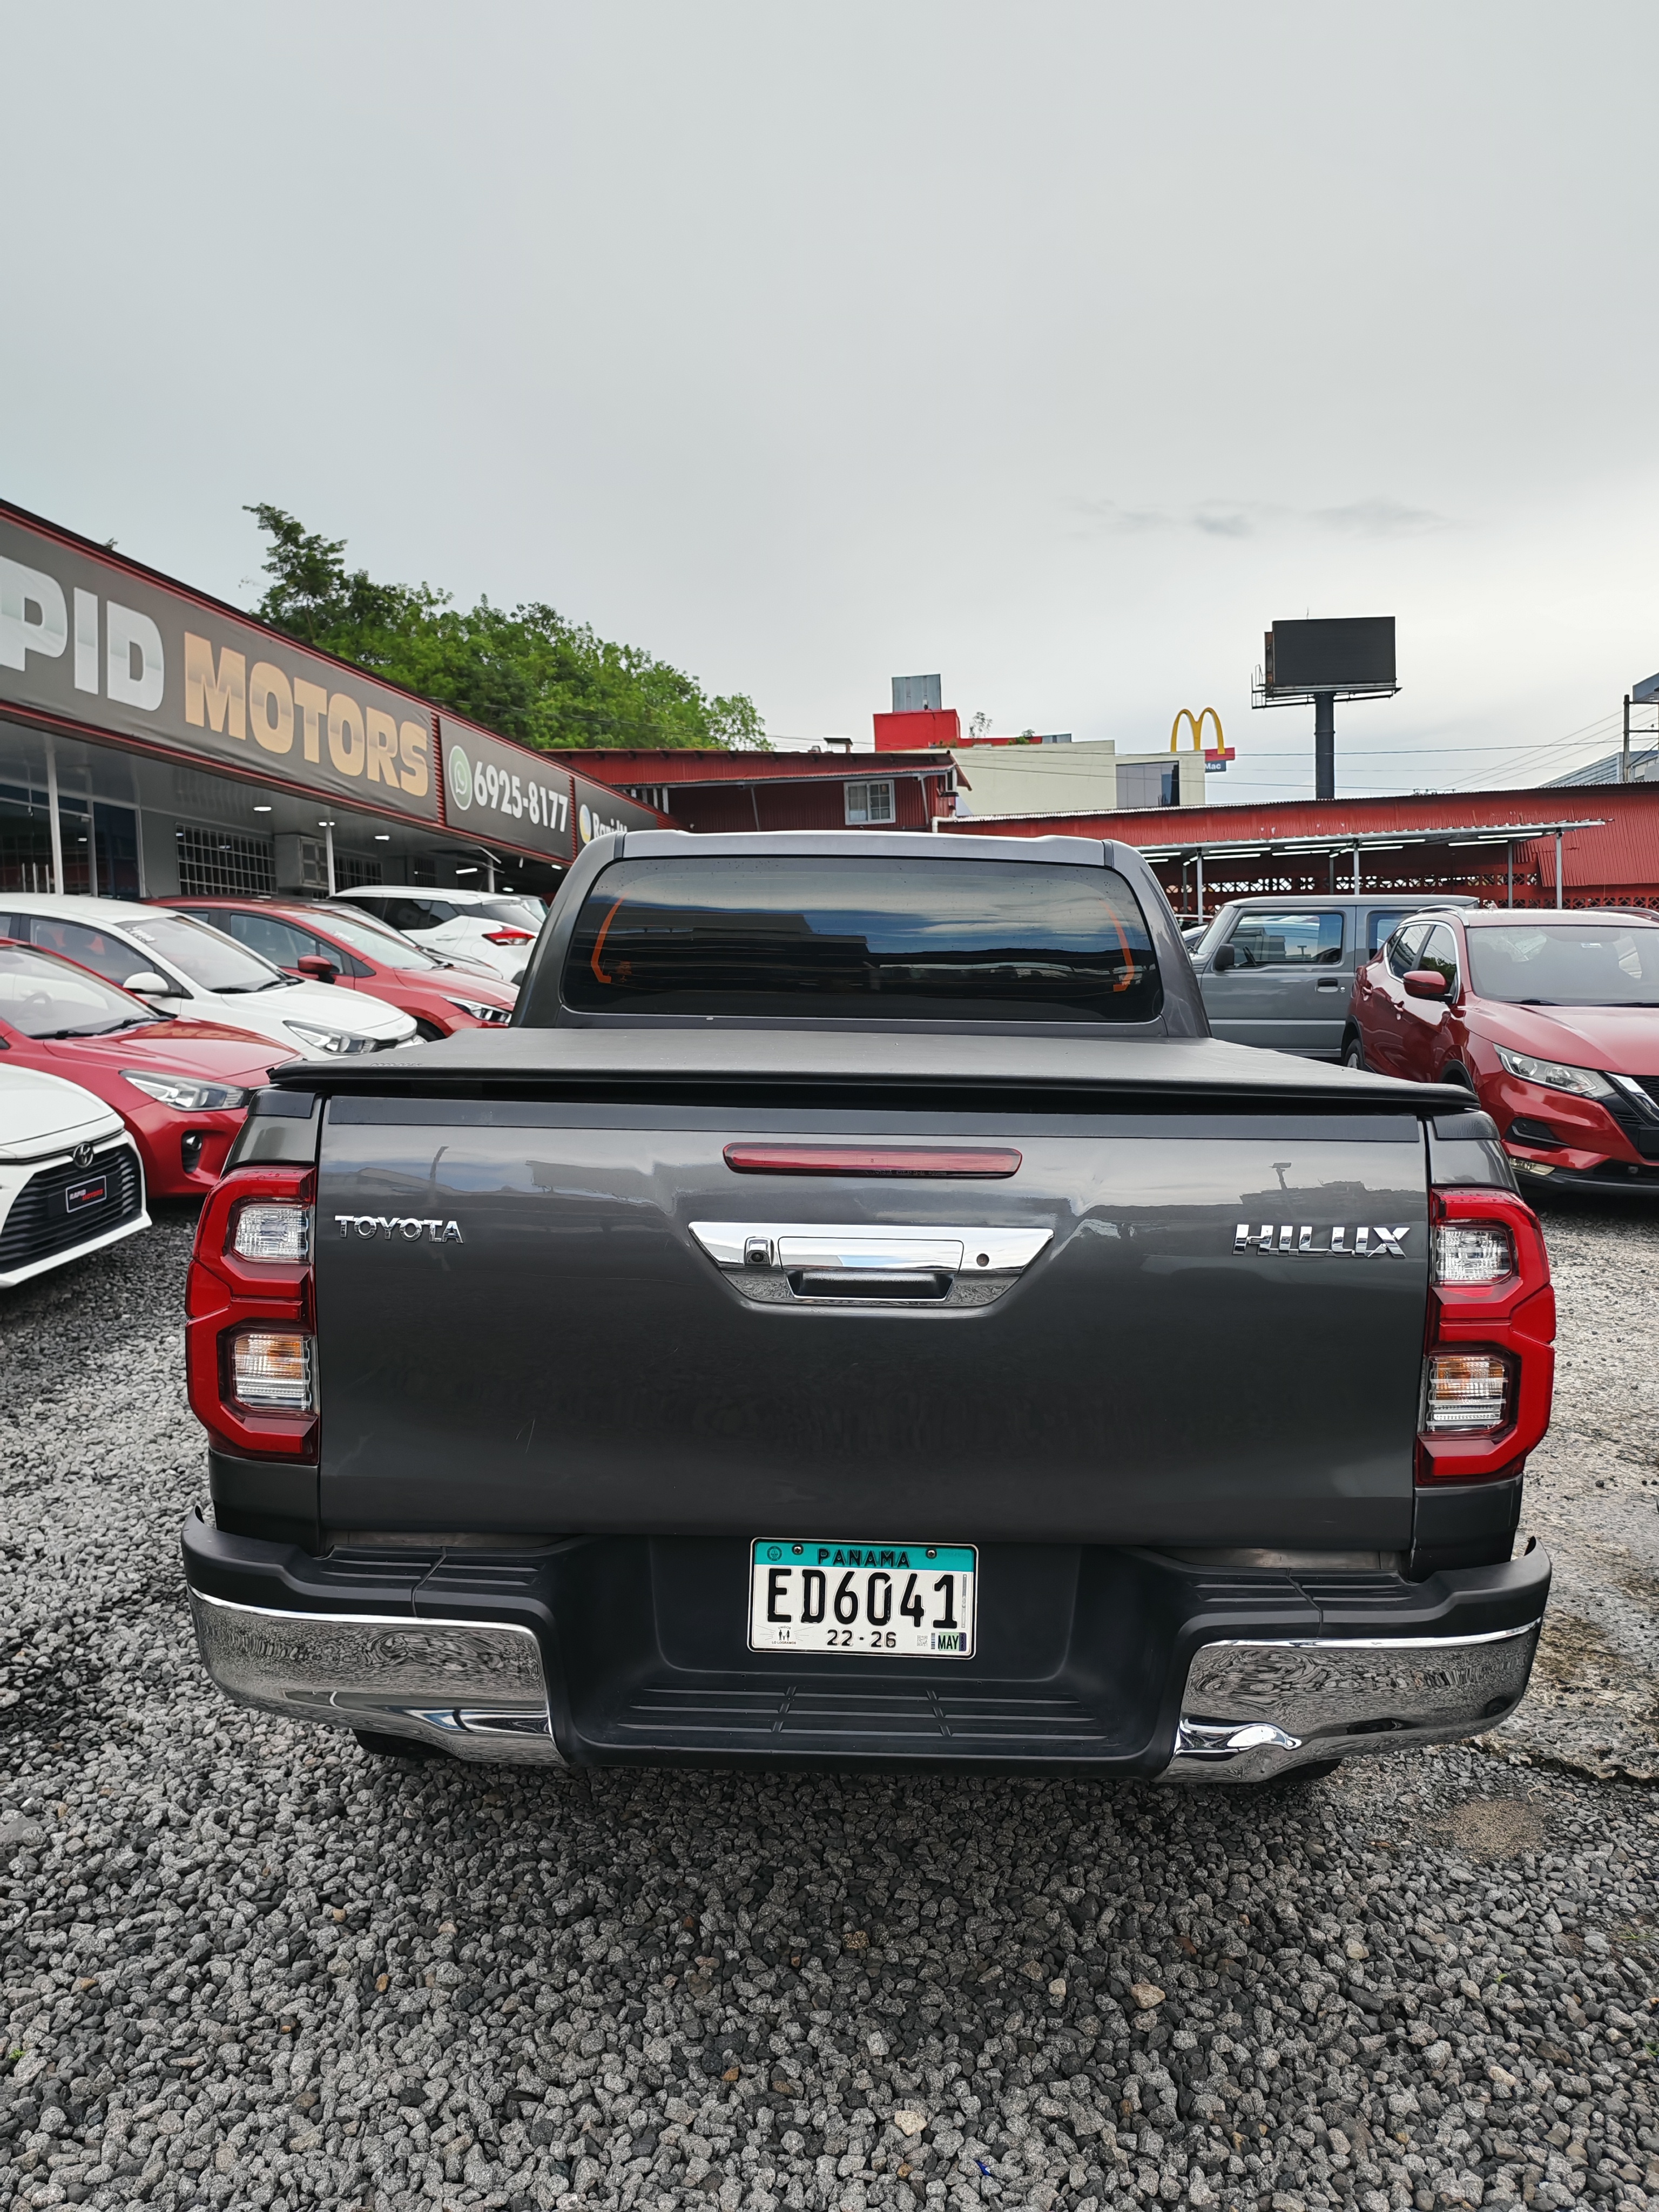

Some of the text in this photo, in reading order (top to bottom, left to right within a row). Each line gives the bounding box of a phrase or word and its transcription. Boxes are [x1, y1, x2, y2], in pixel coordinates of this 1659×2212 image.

[184, 631, 429, 798] MOTORS
[474, 761, 569, 833] 6925-8177
[335, 1215, 464, 1244] TOYOTA
[1232, 1224, 1410, 1259] HILUX
[818, 1548, 910, 1567] PANAMA
[767, 1568, 958, 1629] ED6041
[938, 1635, 959, 1650] MAY
